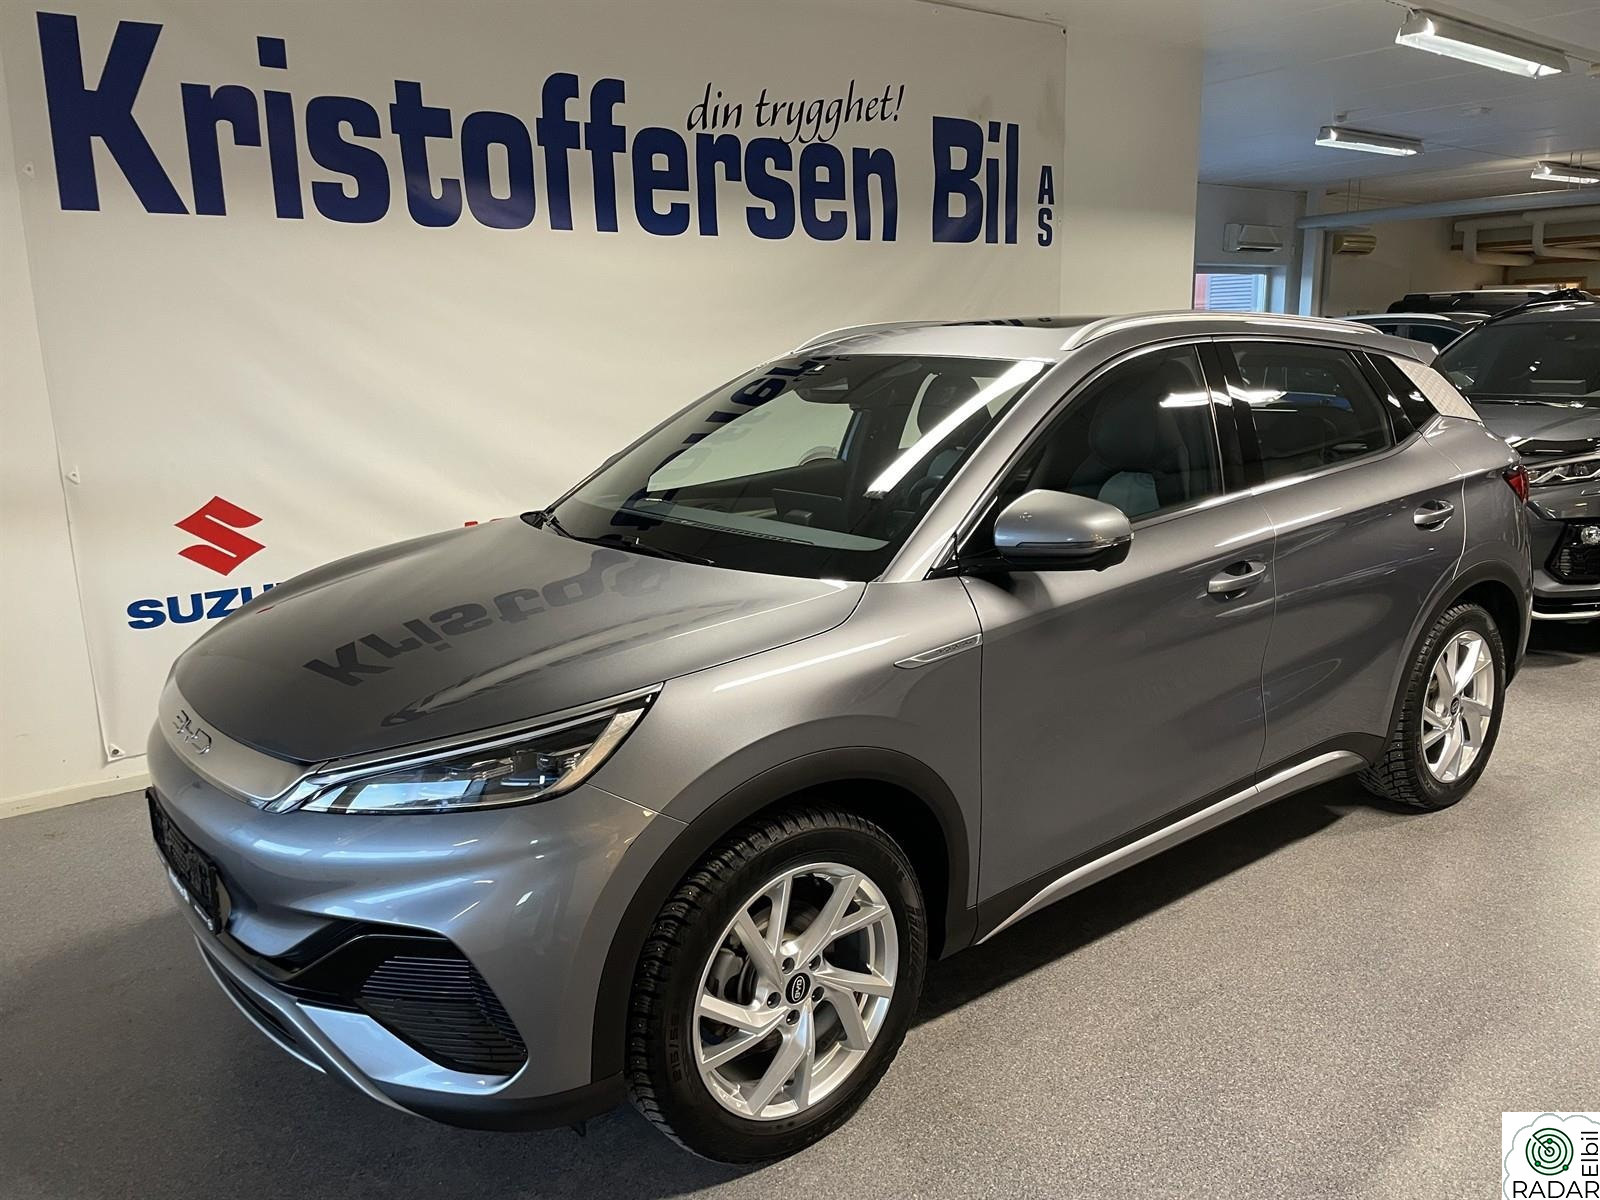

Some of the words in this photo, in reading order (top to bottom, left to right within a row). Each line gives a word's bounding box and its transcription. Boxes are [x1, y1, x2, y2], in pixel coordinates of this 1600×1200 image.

[36, 11, 898, 242] Kristoffersen
[933, 115, 1020, 245] Bil
[687, 82, 743, 131] din
[755, 79, 905, 144] trygghet!
